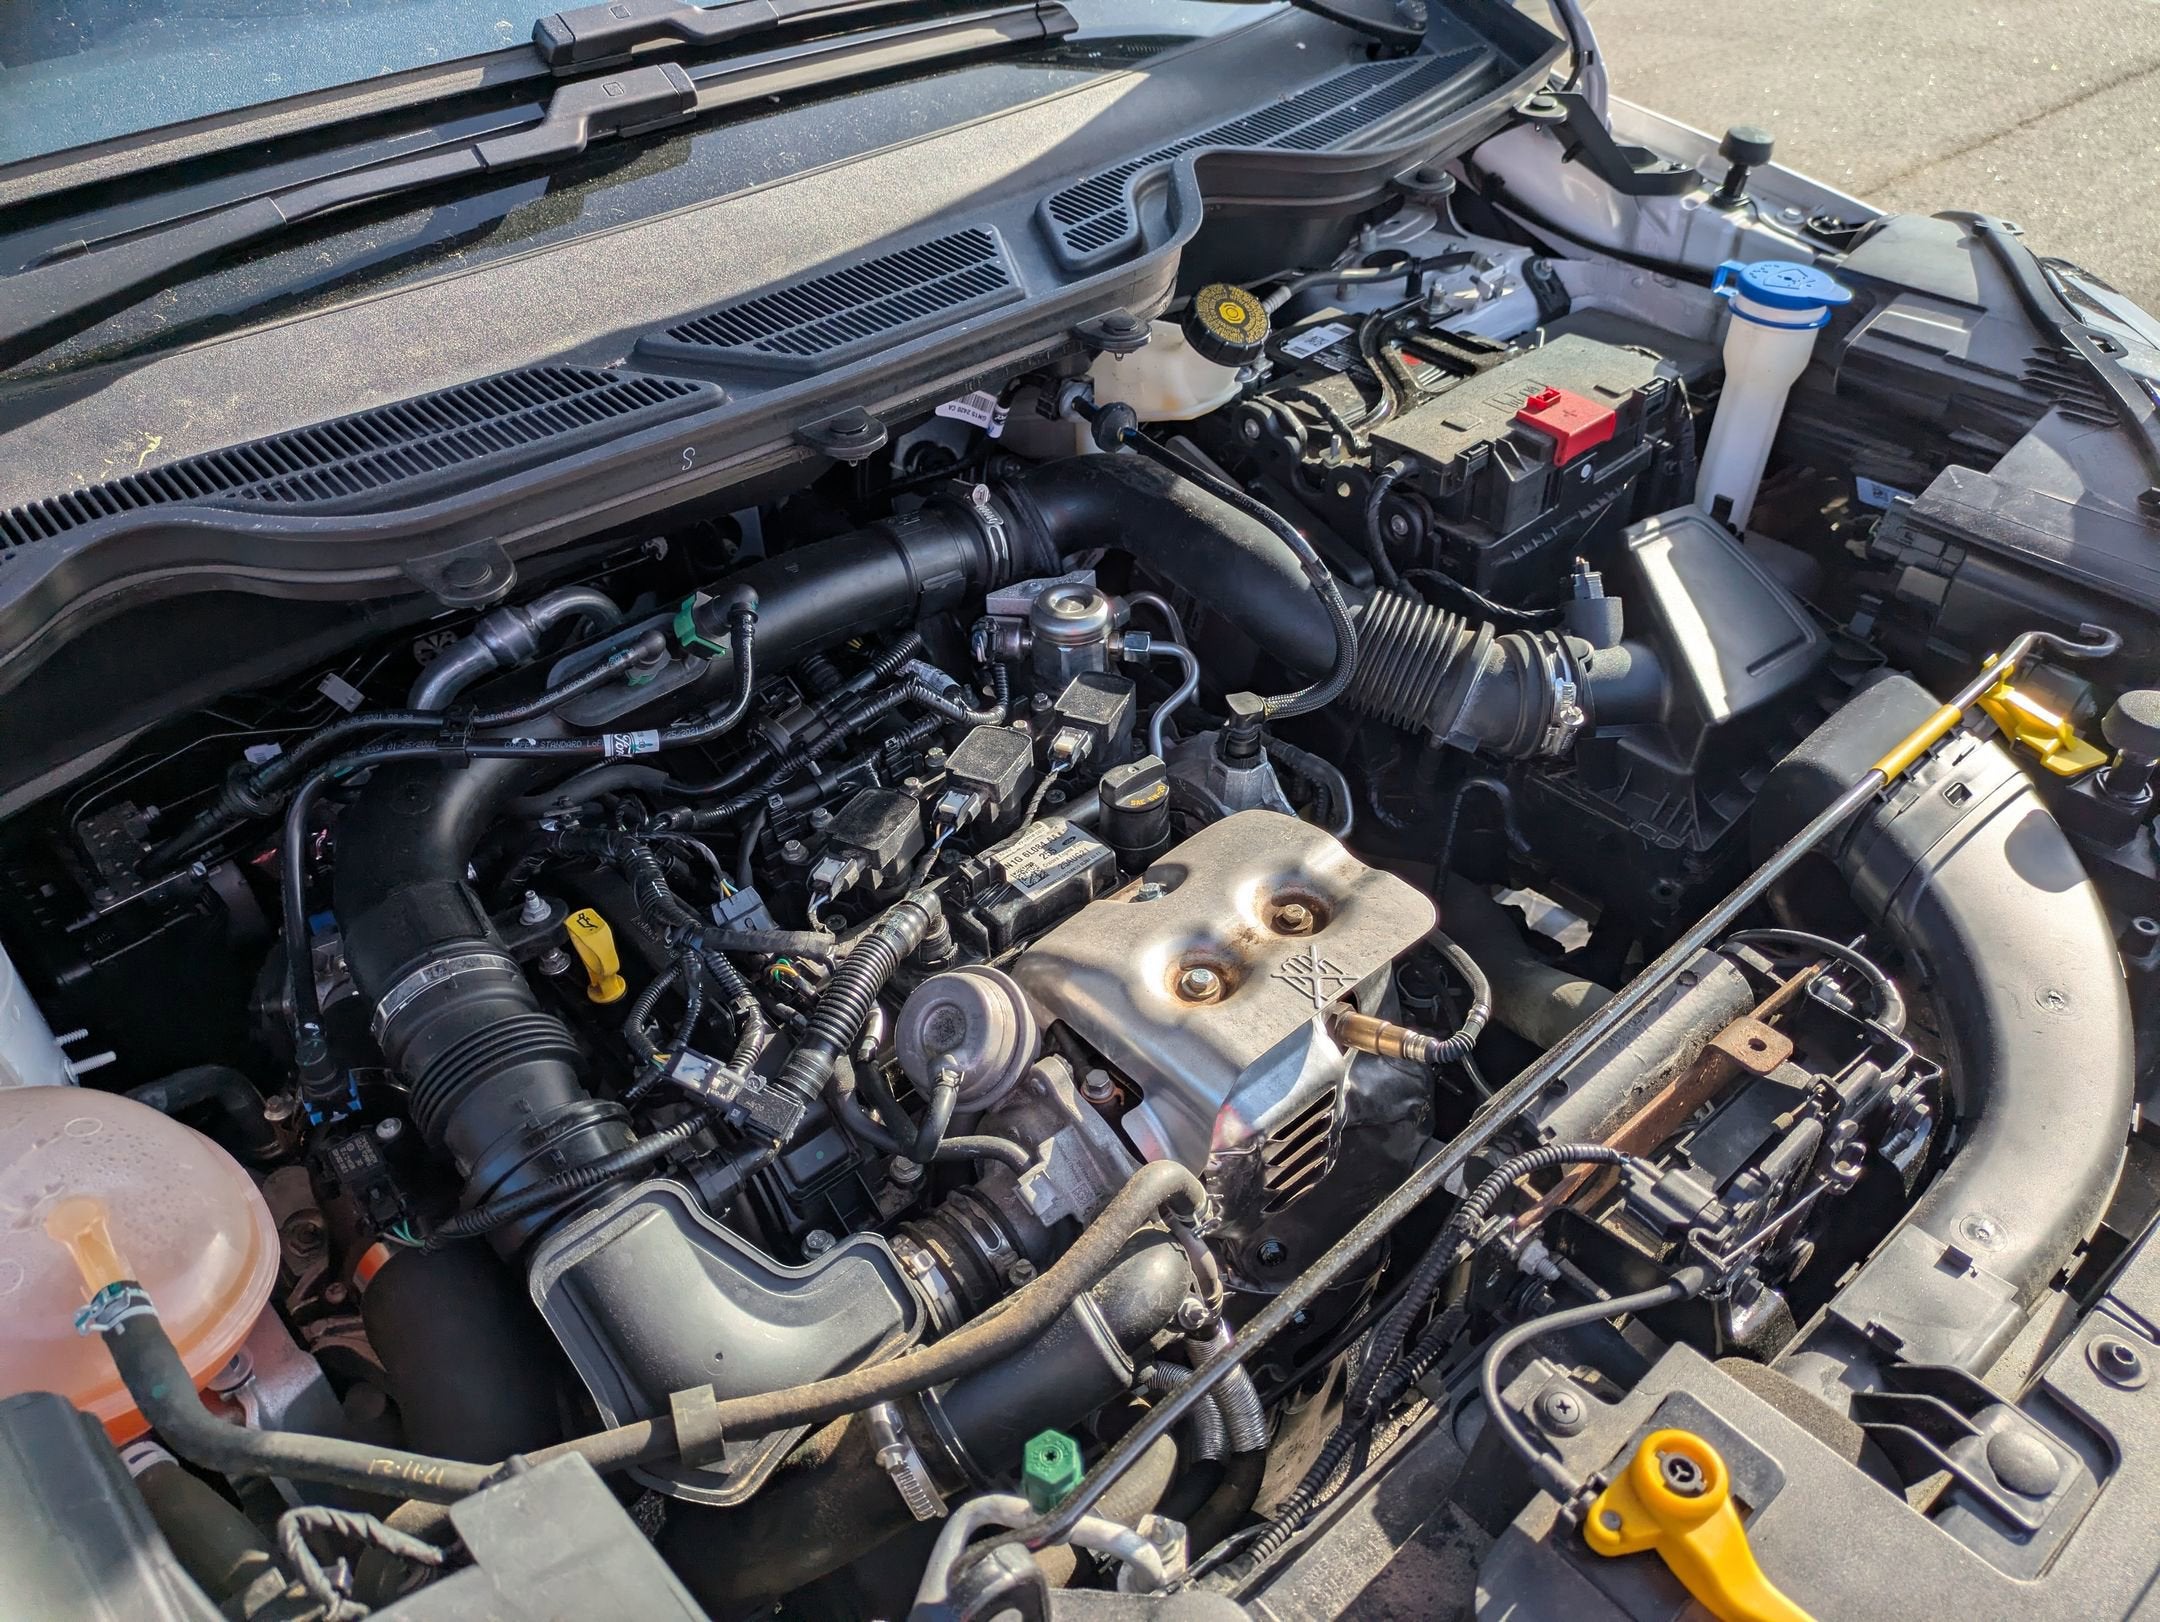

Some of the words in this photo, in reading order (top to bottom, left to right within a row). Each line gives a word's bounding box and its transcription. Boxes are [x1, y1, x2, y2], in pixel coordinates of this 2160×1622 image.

[682, 446, 696, 471] S
[540, 740, 582, 749] STANDARD
[613, 733, 634, 756] For
[1039, 846, 1057, 860] 255
[1057, 847, 1090, 870] 25AUG21
